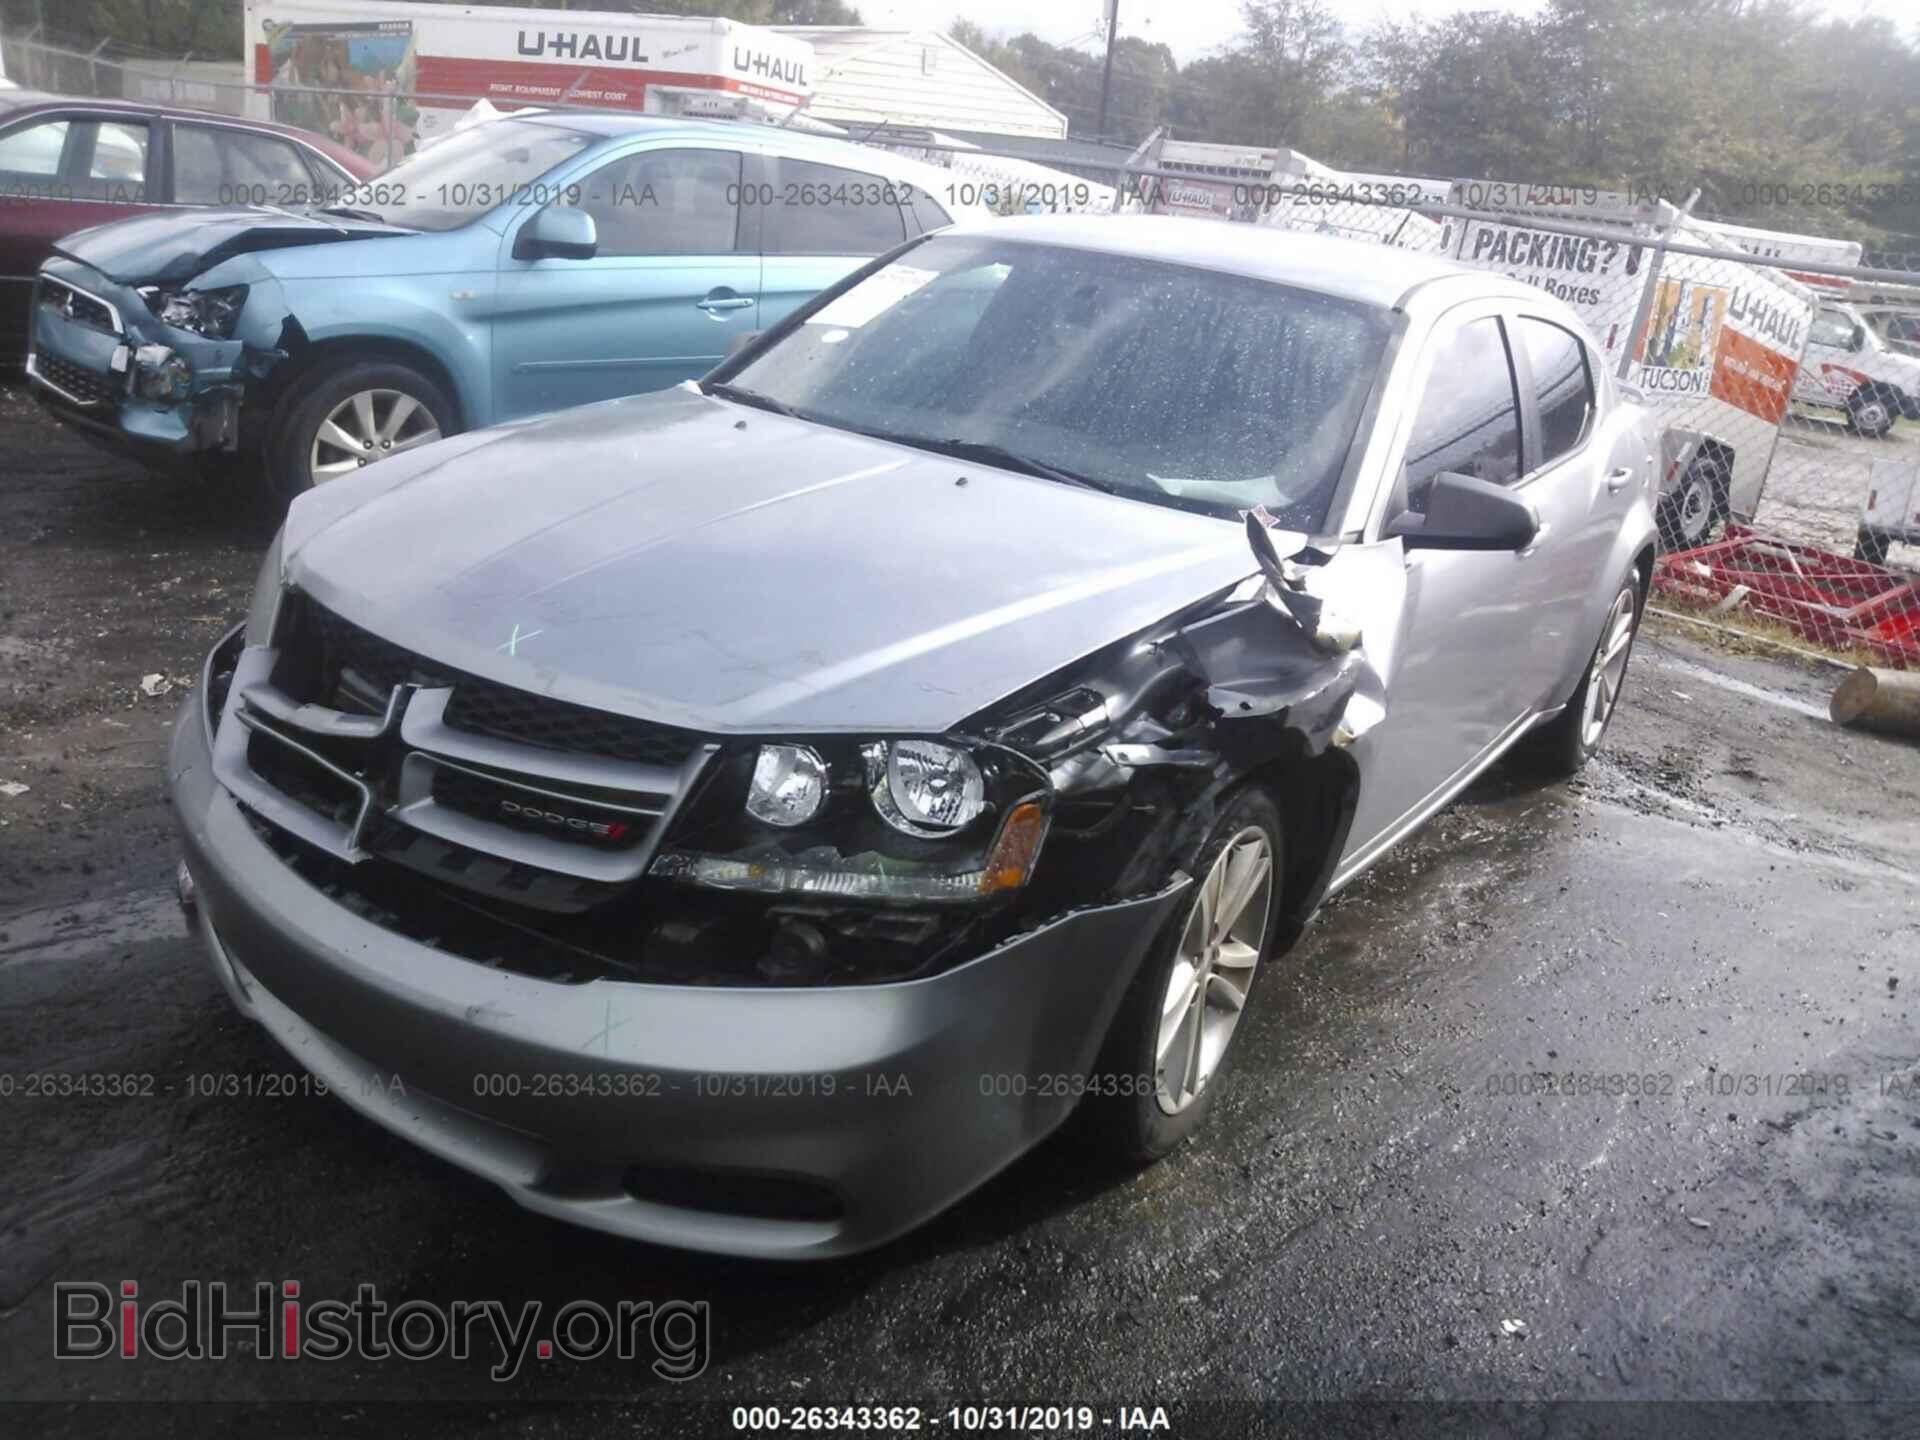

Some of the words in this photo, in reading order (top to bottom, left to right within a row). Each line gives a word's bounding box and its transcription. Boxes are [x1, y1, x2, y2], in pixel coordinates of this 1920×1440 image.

[518, 31, 648, 62] U-HAUL
[734, 46, 807, 86] U-HAUL
[1472, 228, 1618, 275] PACKING?
[1544, 277, 1600, 305] Boxes
[1640, 367, 1703, 391] TUCSON
[501, 800, 610, 834] DODGE
